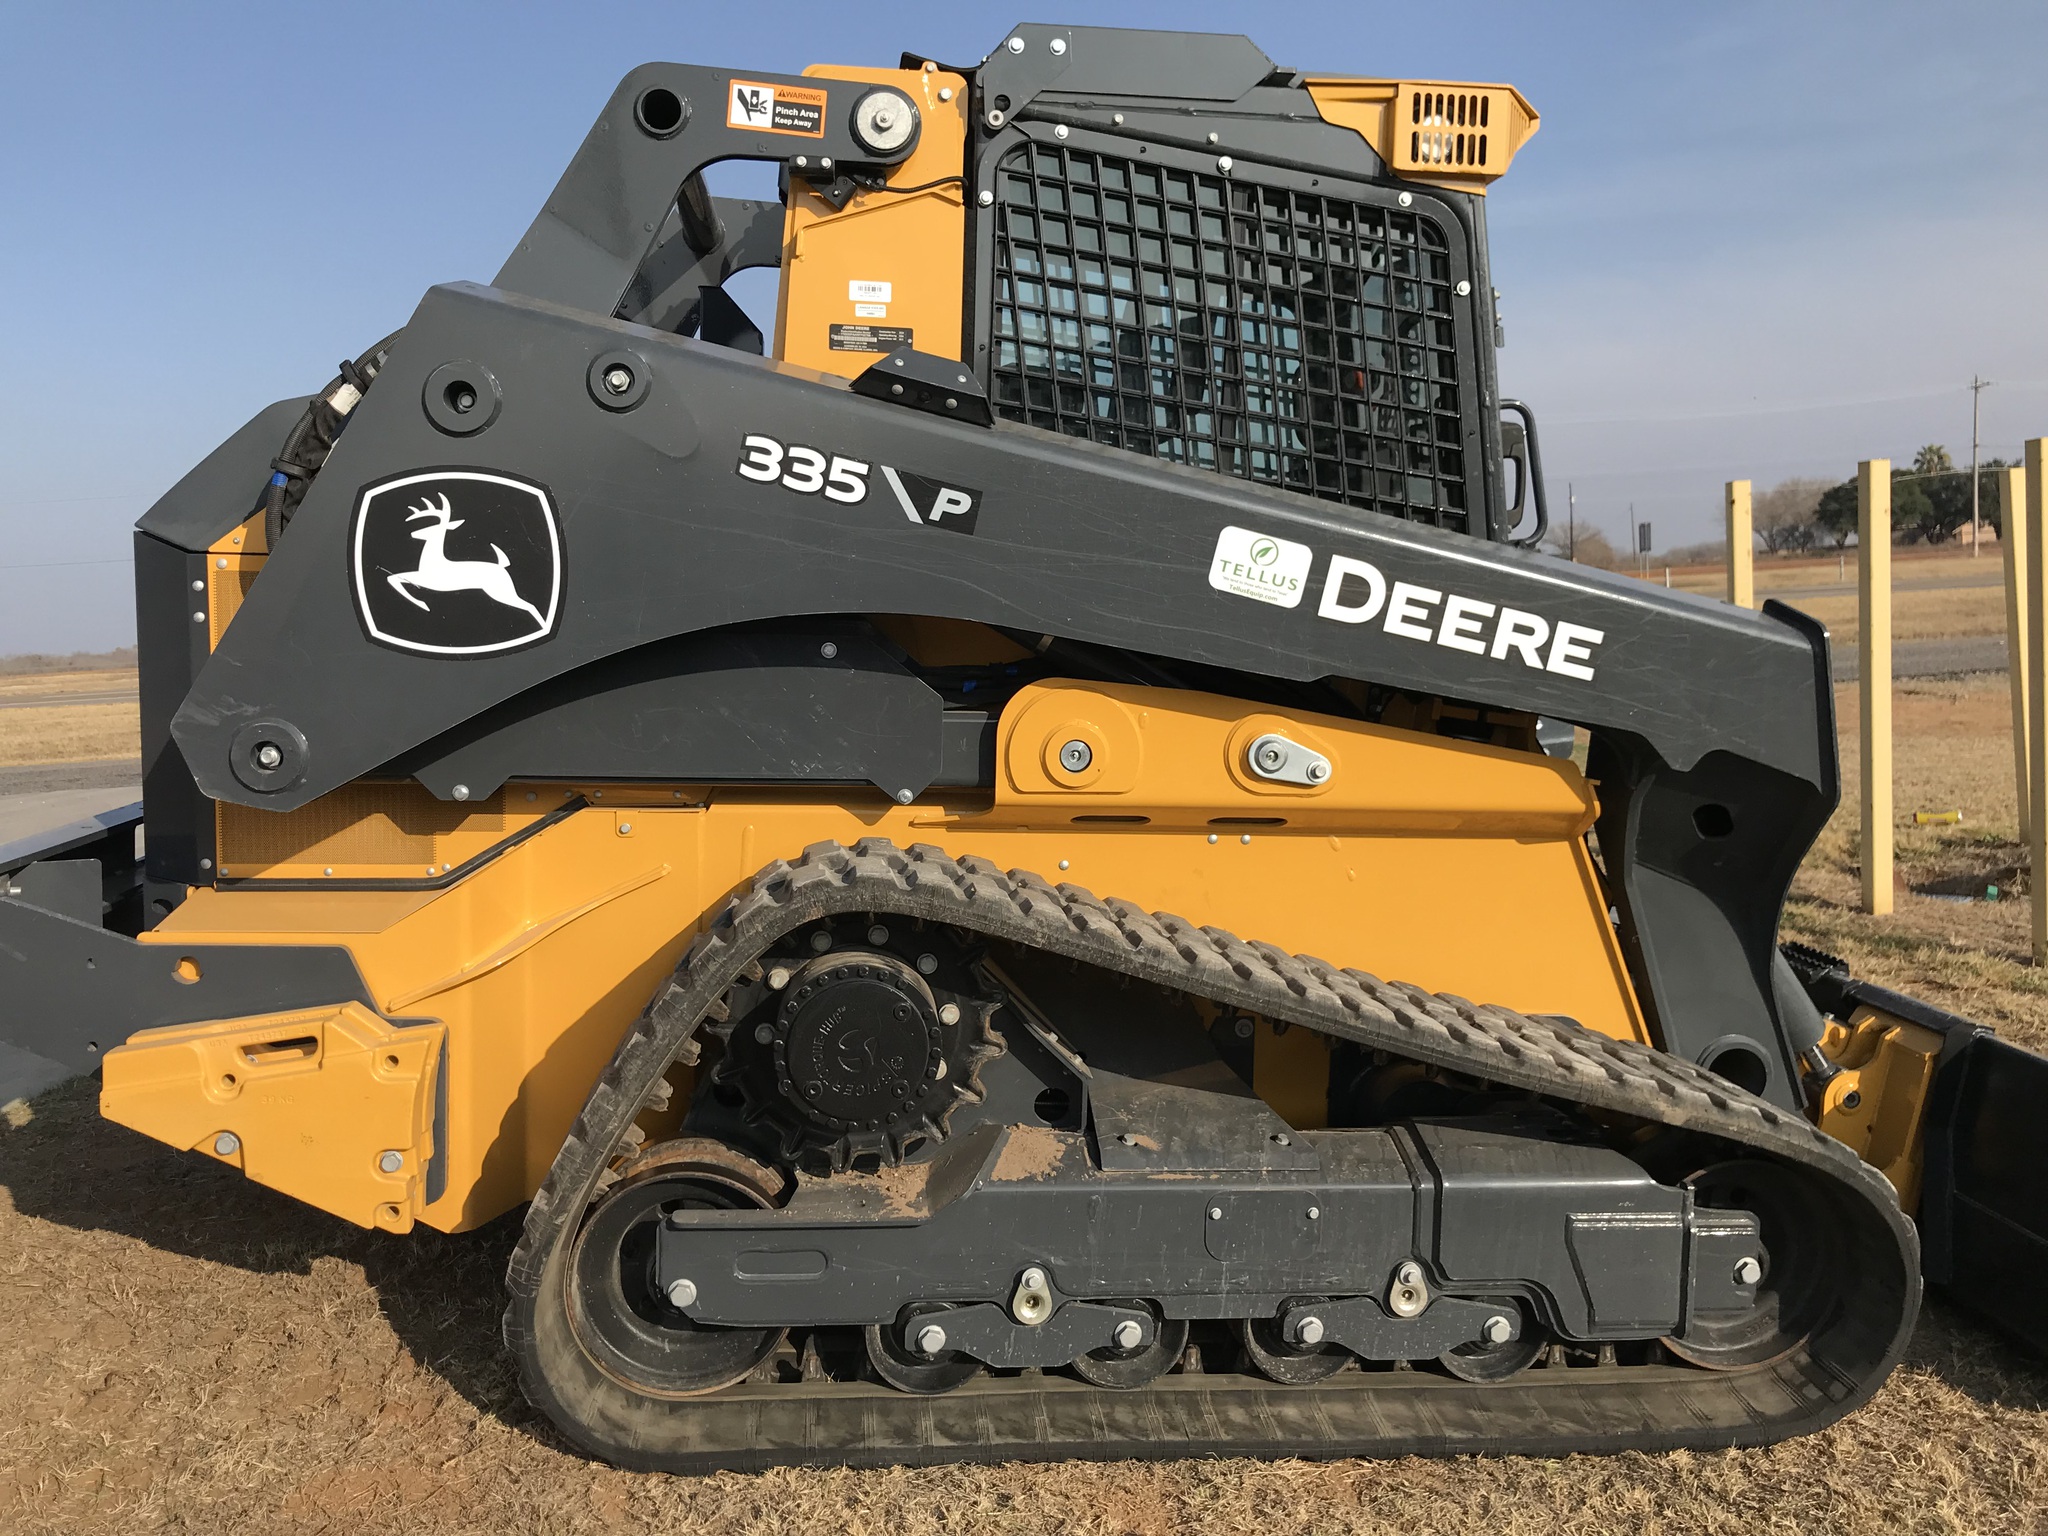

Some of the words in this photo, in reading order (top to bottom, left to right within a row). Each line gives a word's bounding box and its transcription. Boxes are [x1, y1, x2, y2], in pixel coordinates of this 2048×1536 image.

[785, 90, 821, 102] WARNING
[776, 106, 798, 117] Pinch
[800, 109, 819, 119] Area
[775, 116, 792, 126] Keep
[793, 119, 812, 129] Away
[738, 435, 870, 504] 335
[1220, 559, 1298, 591] TELLUS
[1230, 584, 1278, 602] TellusEquip.com
[1317, 553, 1605, 682] DEERE
